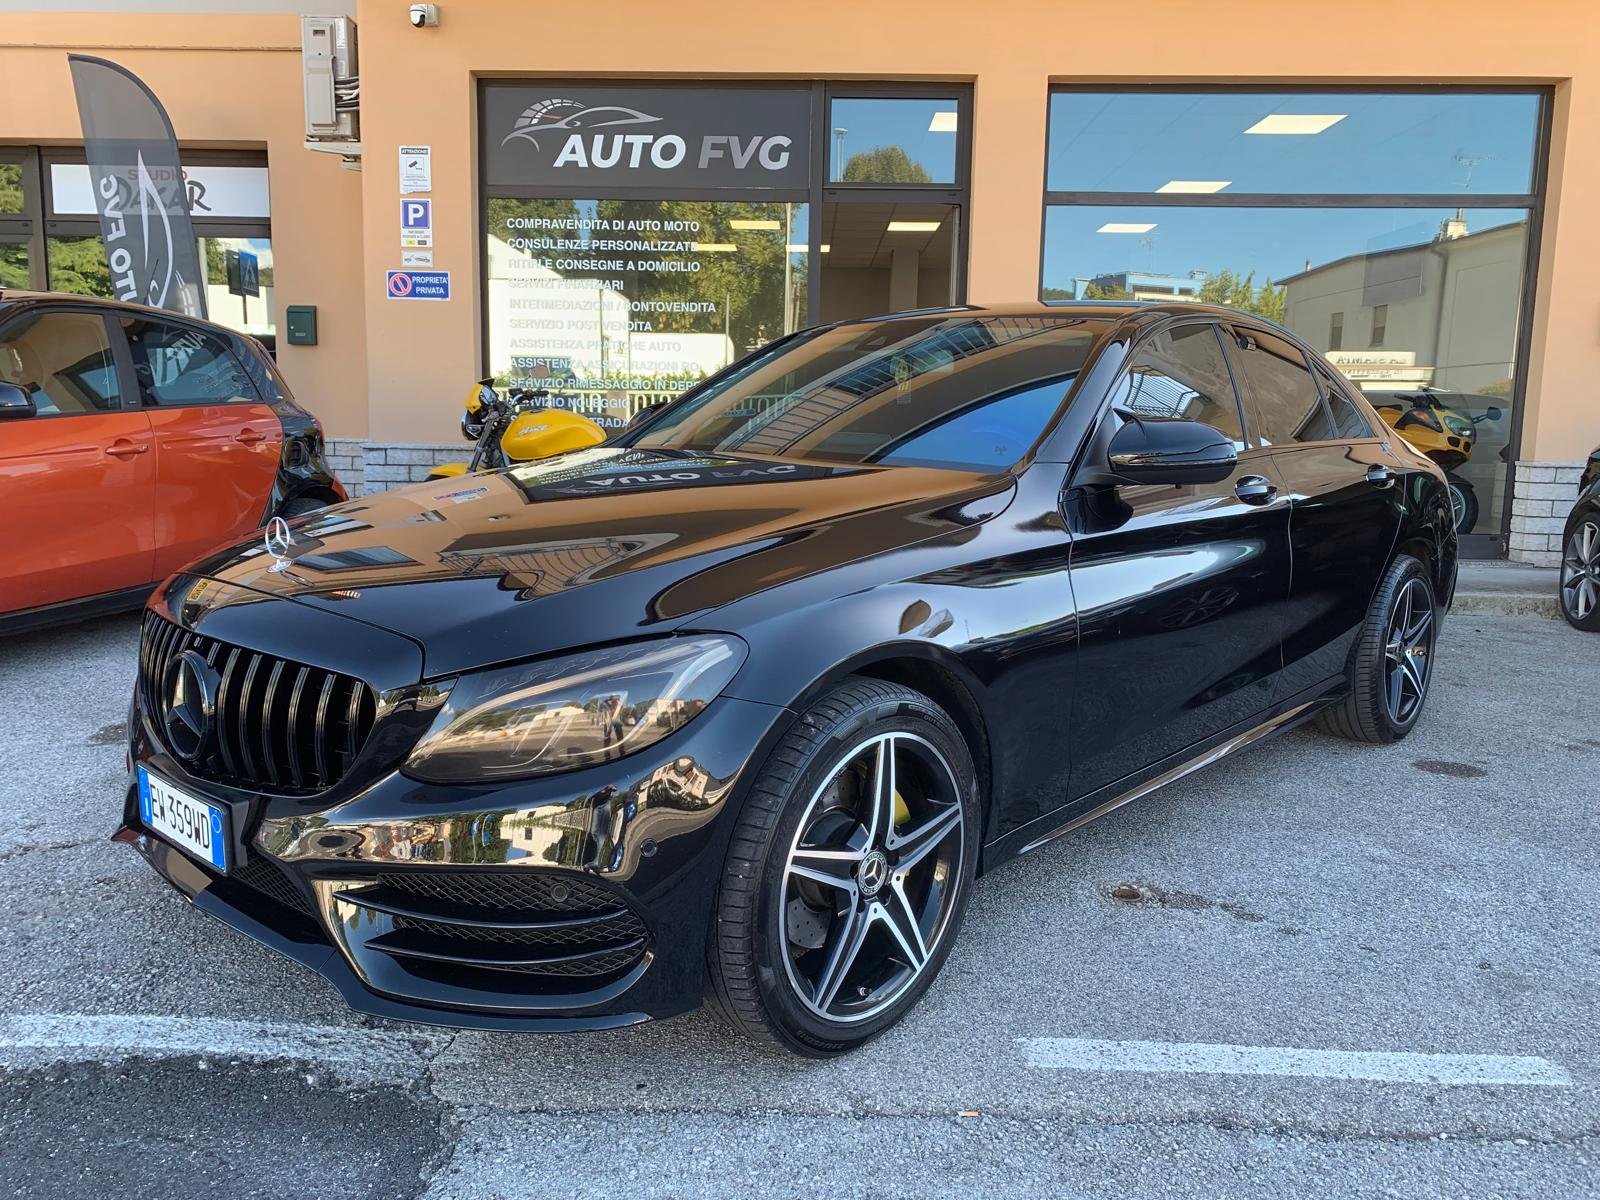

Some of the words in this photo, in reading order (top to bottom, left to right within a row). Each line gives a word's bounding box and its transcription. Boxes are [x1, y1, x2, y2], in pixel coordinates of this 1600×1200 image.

[552, 134, 686, 169] AUTO
[698, 135, 793, 170] FVG
[127, 168, 188, 181] SUDIO
[408, 203, 424, 225] P
[506, 218, 610, 230] COMPRAVENDITA
[612, 220, 625, 230] DI
[627, 220, 661, 231] AUTO
[664, 221, 700, 232] MOTO
[507, 238, 589, 250] CONSULENZE
[591, 240, 698, 252] PERSONALIZZATE
[545, 260, 553, 269] E
[556, 260, 624, 271] CONSEGNE
[626, 261, 635, 271] A
[637, 261, 700, 272] DOMICILIO
[509, 278, 556, 288] SERVIZI
[416, 286, 444, 294] PRIVATA
[509, 299, 613, 311] INTERMEDIAZIONI
[509, 319, 564, 330] SERVIZIO
[509, 338, 583, 349] ASSISTENZA
[650, 341, 681, 352] AUTO
[509, 358, 583, 369] ASSISTENZA
[509, 378, 564, 389] SERVIZIO
[567, 379, 650, 390] RIMESSAGGIO
[654, 380, 667, 390] IN
[567, 397, 631, 409] NOLEGGIO
[150, 783, 166, 823] EW
[167, 794, 210, 849] 359WD
